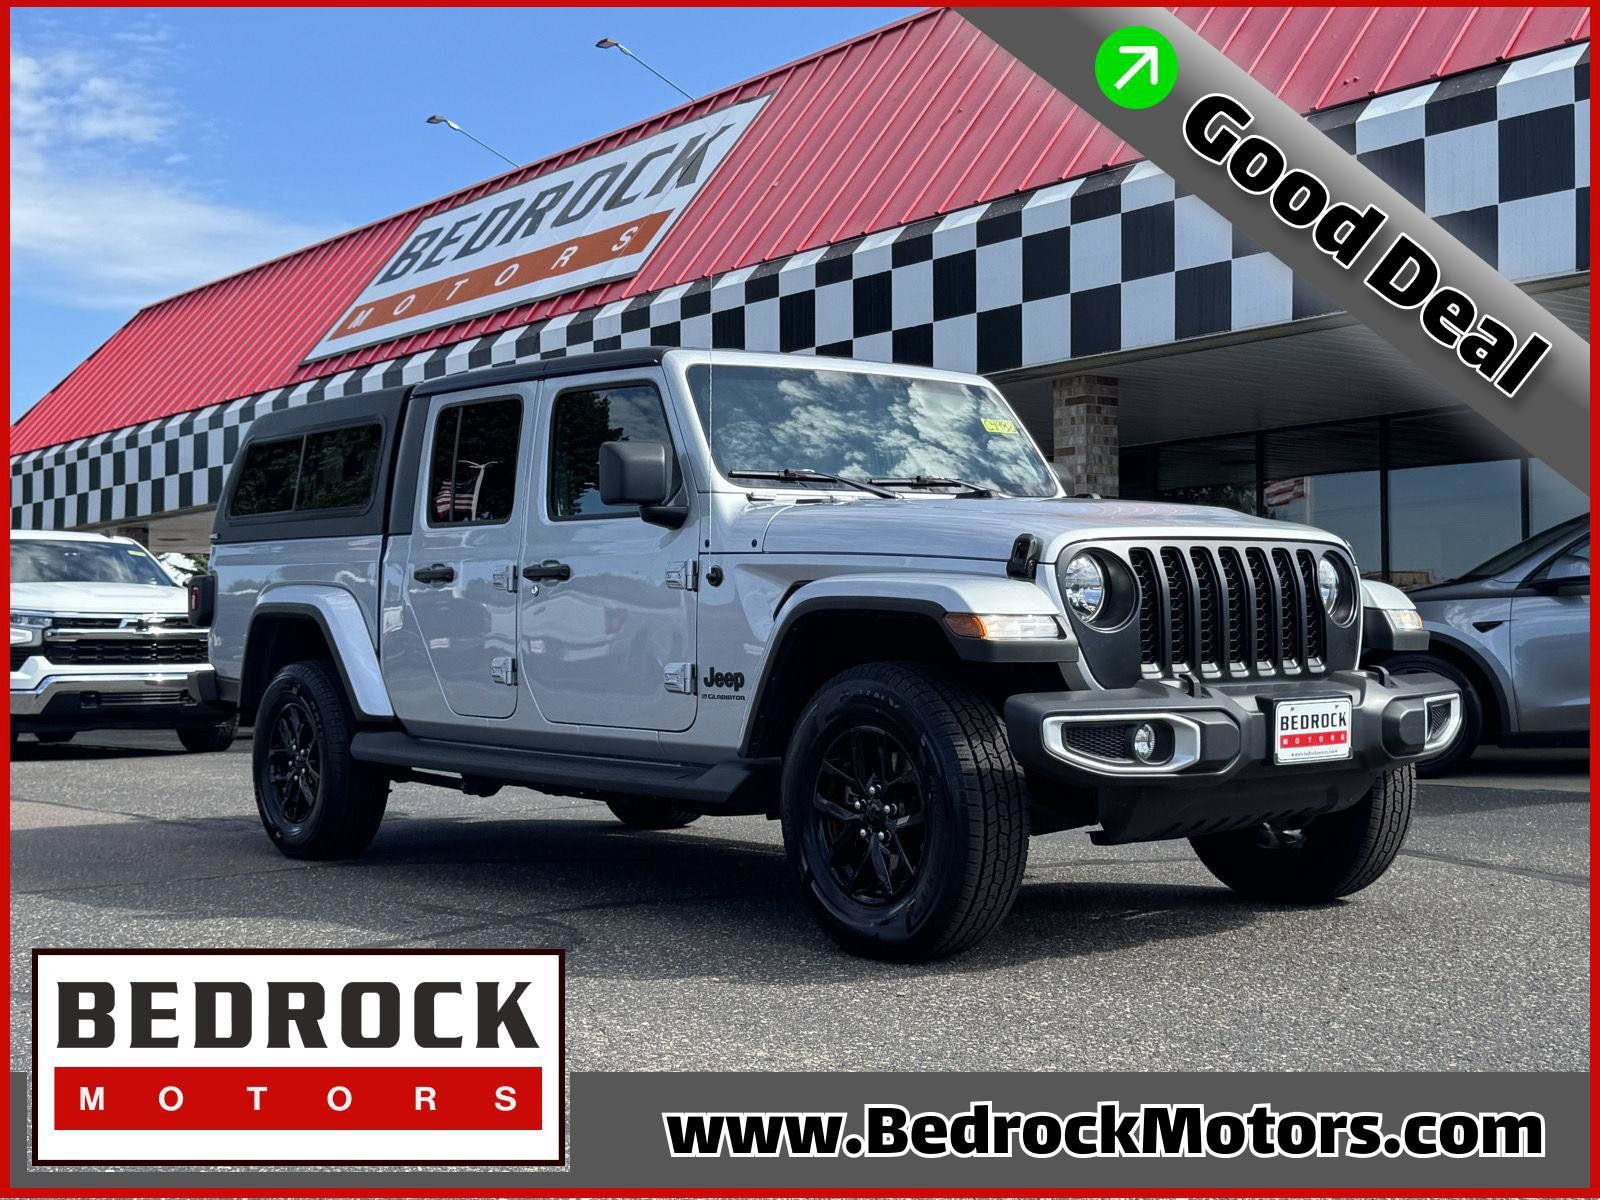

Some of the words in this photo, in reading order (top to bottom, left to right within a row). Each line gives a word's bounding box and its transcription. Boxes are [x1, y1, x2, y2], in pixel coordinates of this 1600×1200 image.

[375, 123, 734, 286] BEDROCK
[347, 225, 639, 330] MOTORS
[703, 666, 745, 691] Jeep
[1280, 712, 1347, 731] BEDROCK
[1283, 734, 1345, 745] MOTORS
